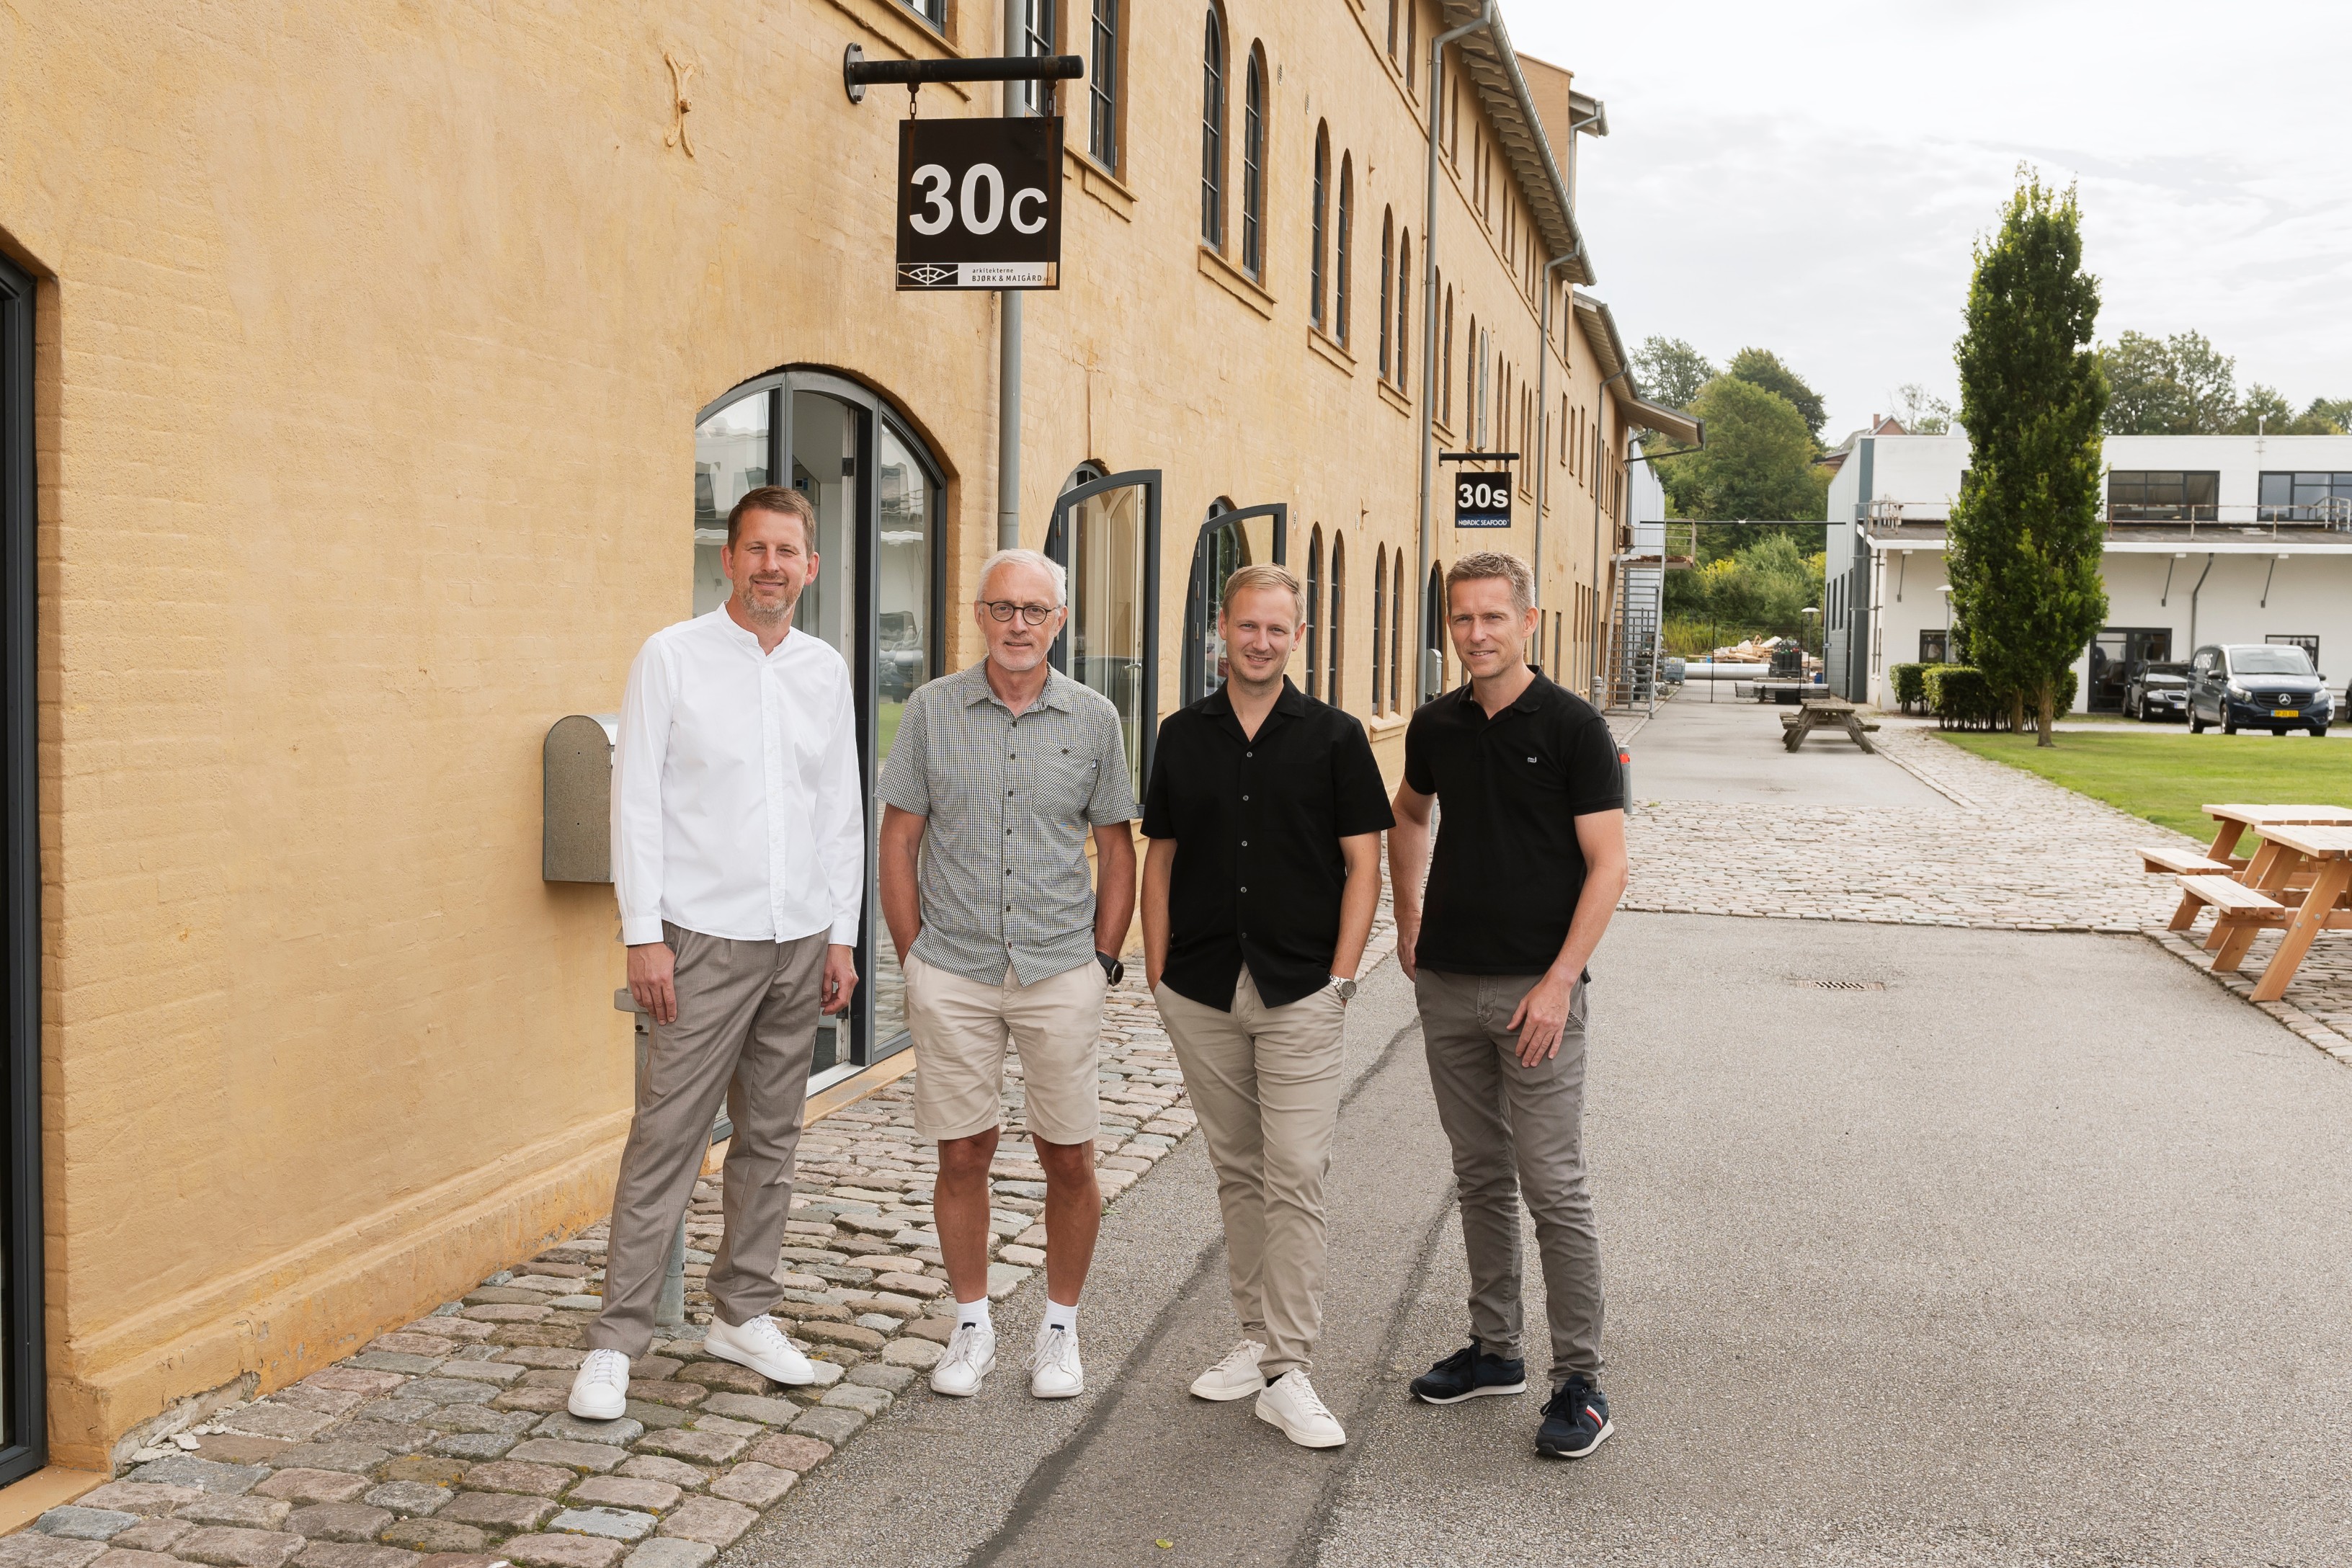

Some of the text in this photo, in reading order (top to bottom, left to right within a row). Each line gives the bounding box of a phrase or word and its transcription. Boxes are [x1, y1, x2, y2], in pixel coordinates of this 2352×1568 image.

[909, 164, 1048, 235] 30c
[1006, 273, 1043, 282] MAIGÅRD
[1458, 484, 1509, 508] 30s
